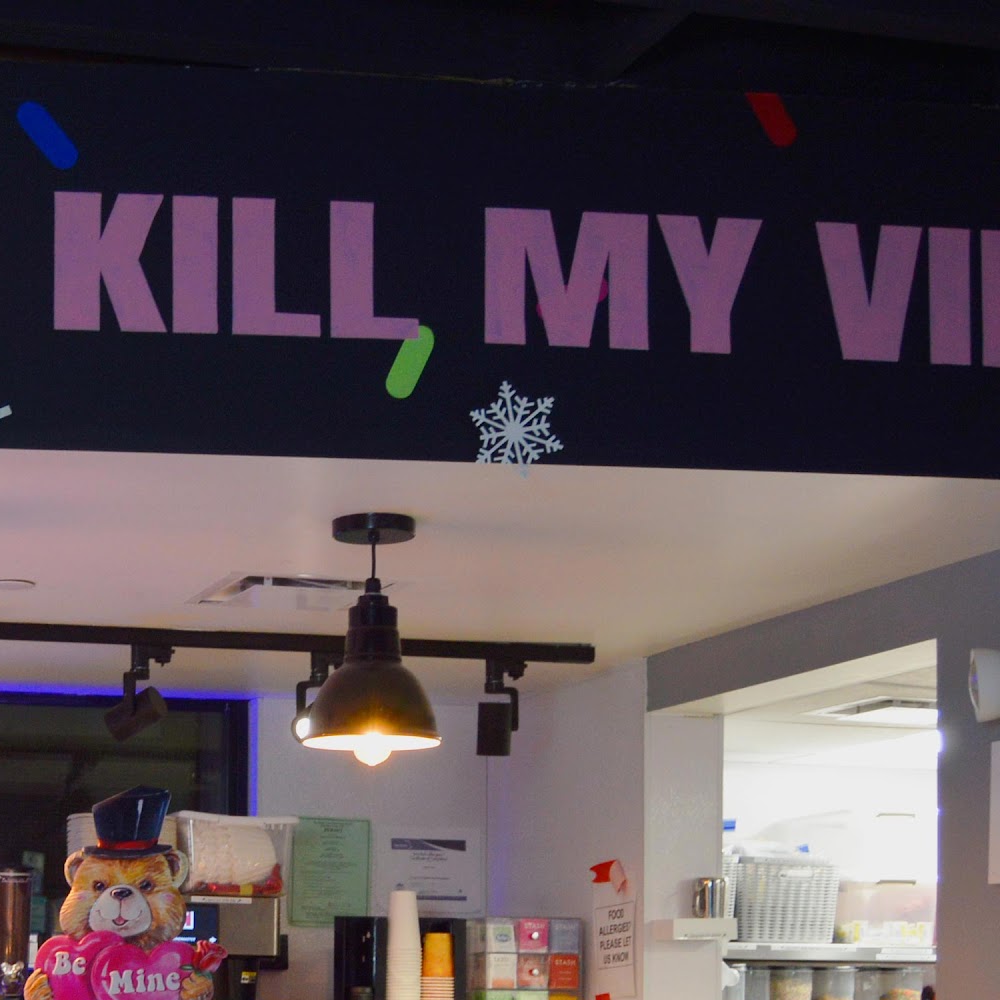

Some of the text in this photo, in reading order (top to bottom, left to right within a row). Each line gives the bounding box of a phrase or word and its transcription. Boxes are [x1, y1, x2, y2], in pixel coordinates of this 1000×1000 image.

[53, 191, 420, 339] KILL
[484, 206, 763, 354] MY
[608, 908, 624, 920] FOOD
[600, 936, 631, 951] PLEASE LET
[52, 951, 86, 975] Be
[603, 952, 629, 964] US KNOW
[108, 969, 180, 994] Mine
